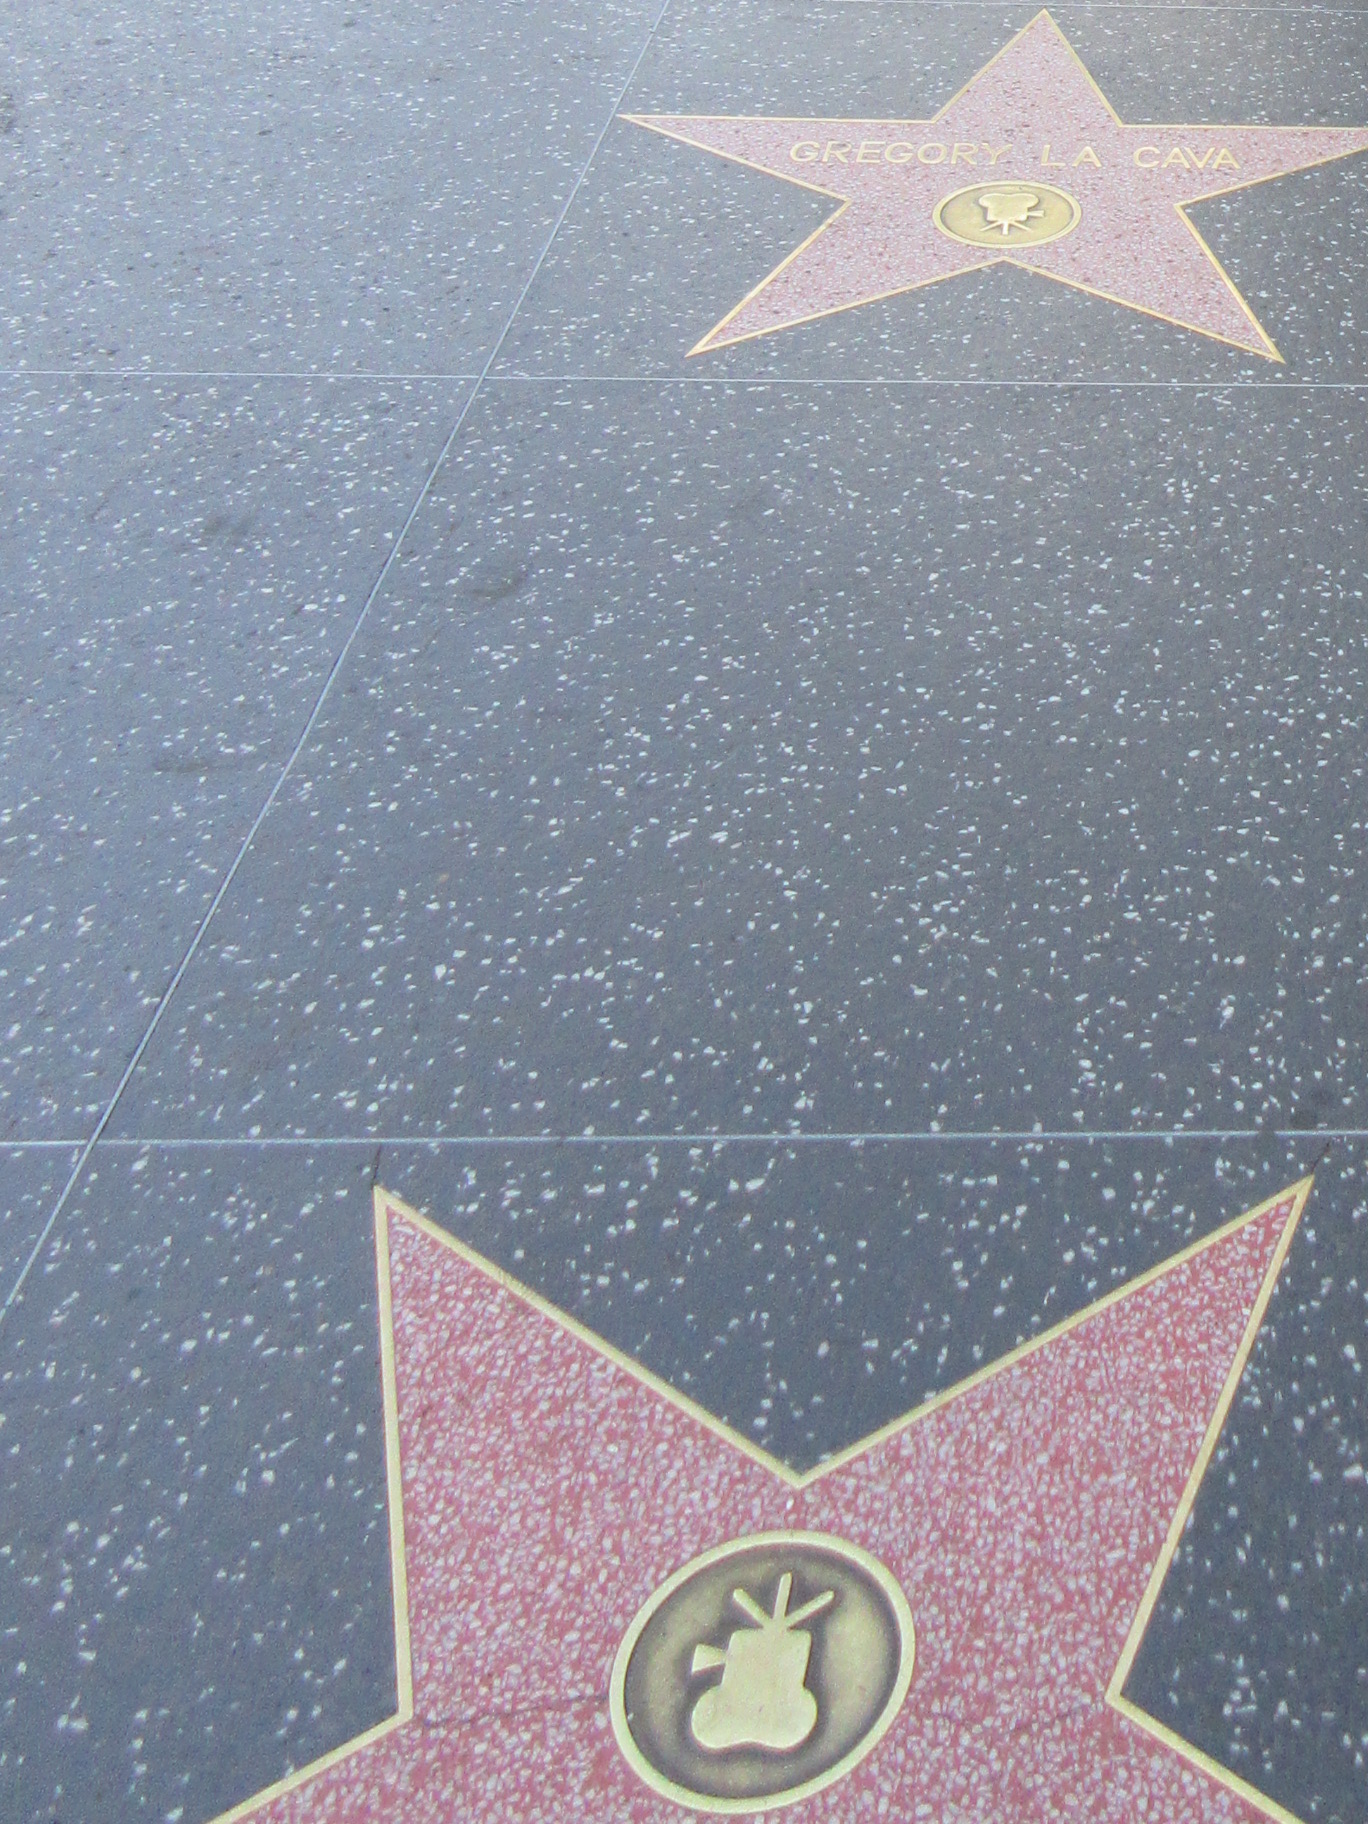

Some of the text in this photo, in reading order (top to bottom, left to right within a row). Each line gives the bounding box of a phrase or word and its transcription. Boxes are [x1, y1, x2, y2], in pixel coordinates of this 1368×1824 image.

[790, 141, 1242, 170] GREGORY LA CAVA
